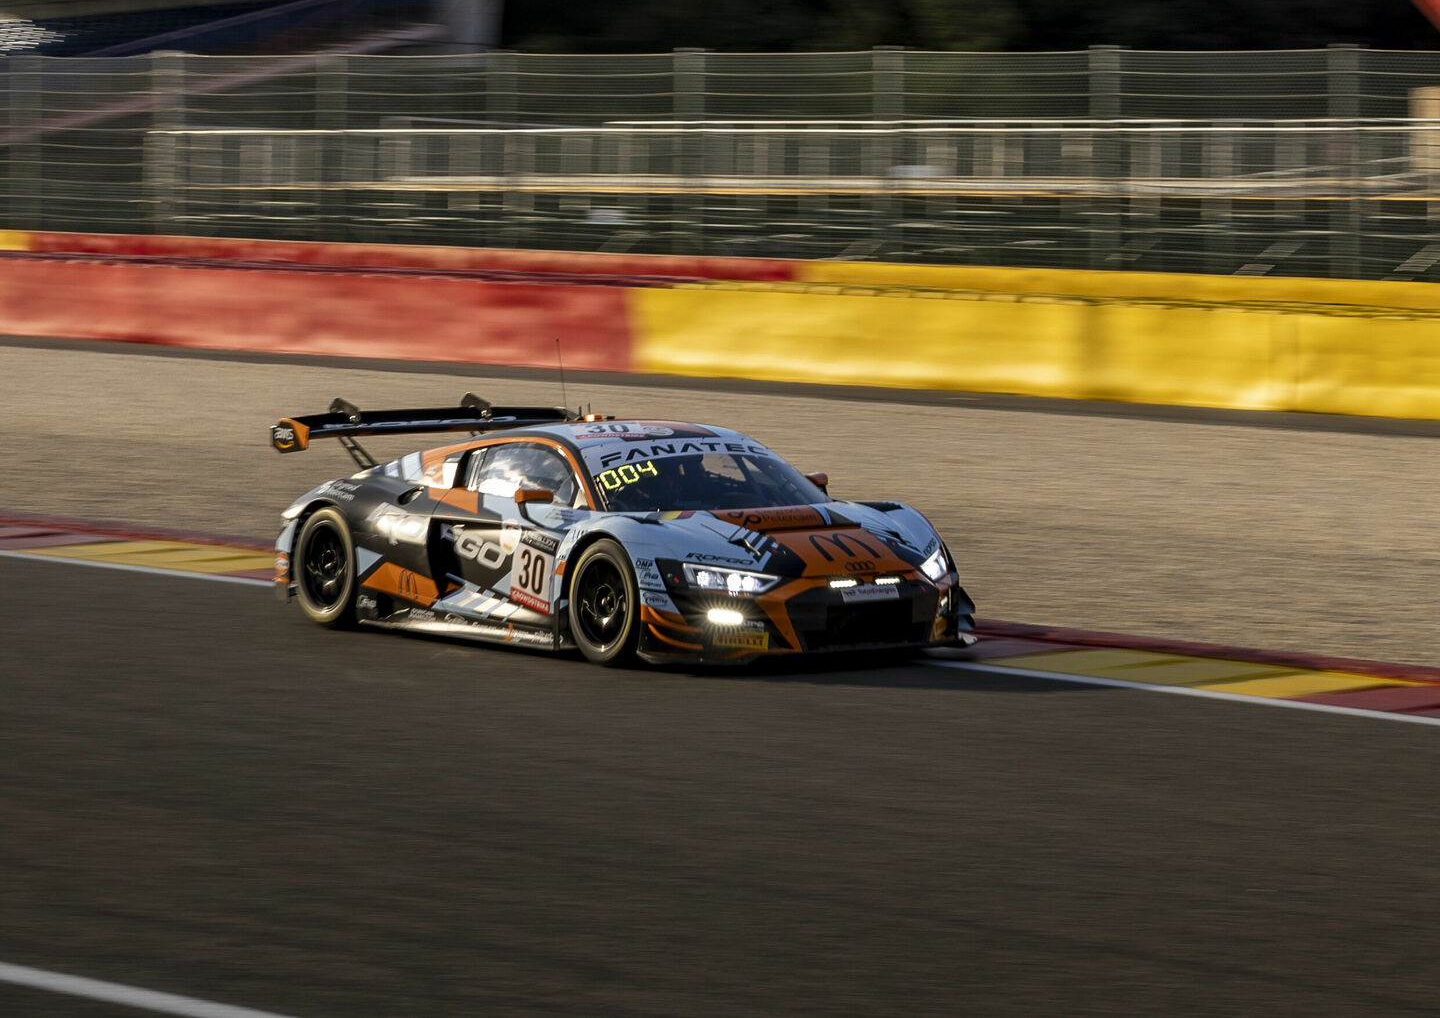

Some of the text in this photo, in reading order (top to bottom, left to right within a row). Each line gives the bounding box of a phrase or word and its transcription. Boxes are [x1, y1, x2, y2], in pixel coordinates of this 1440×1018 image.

[584, 424, 630, 434] 30
[600, 443, 769, 468] FANATEC
[599, 460, 659, 490] 004
[518, 549, 546, 595] 30
